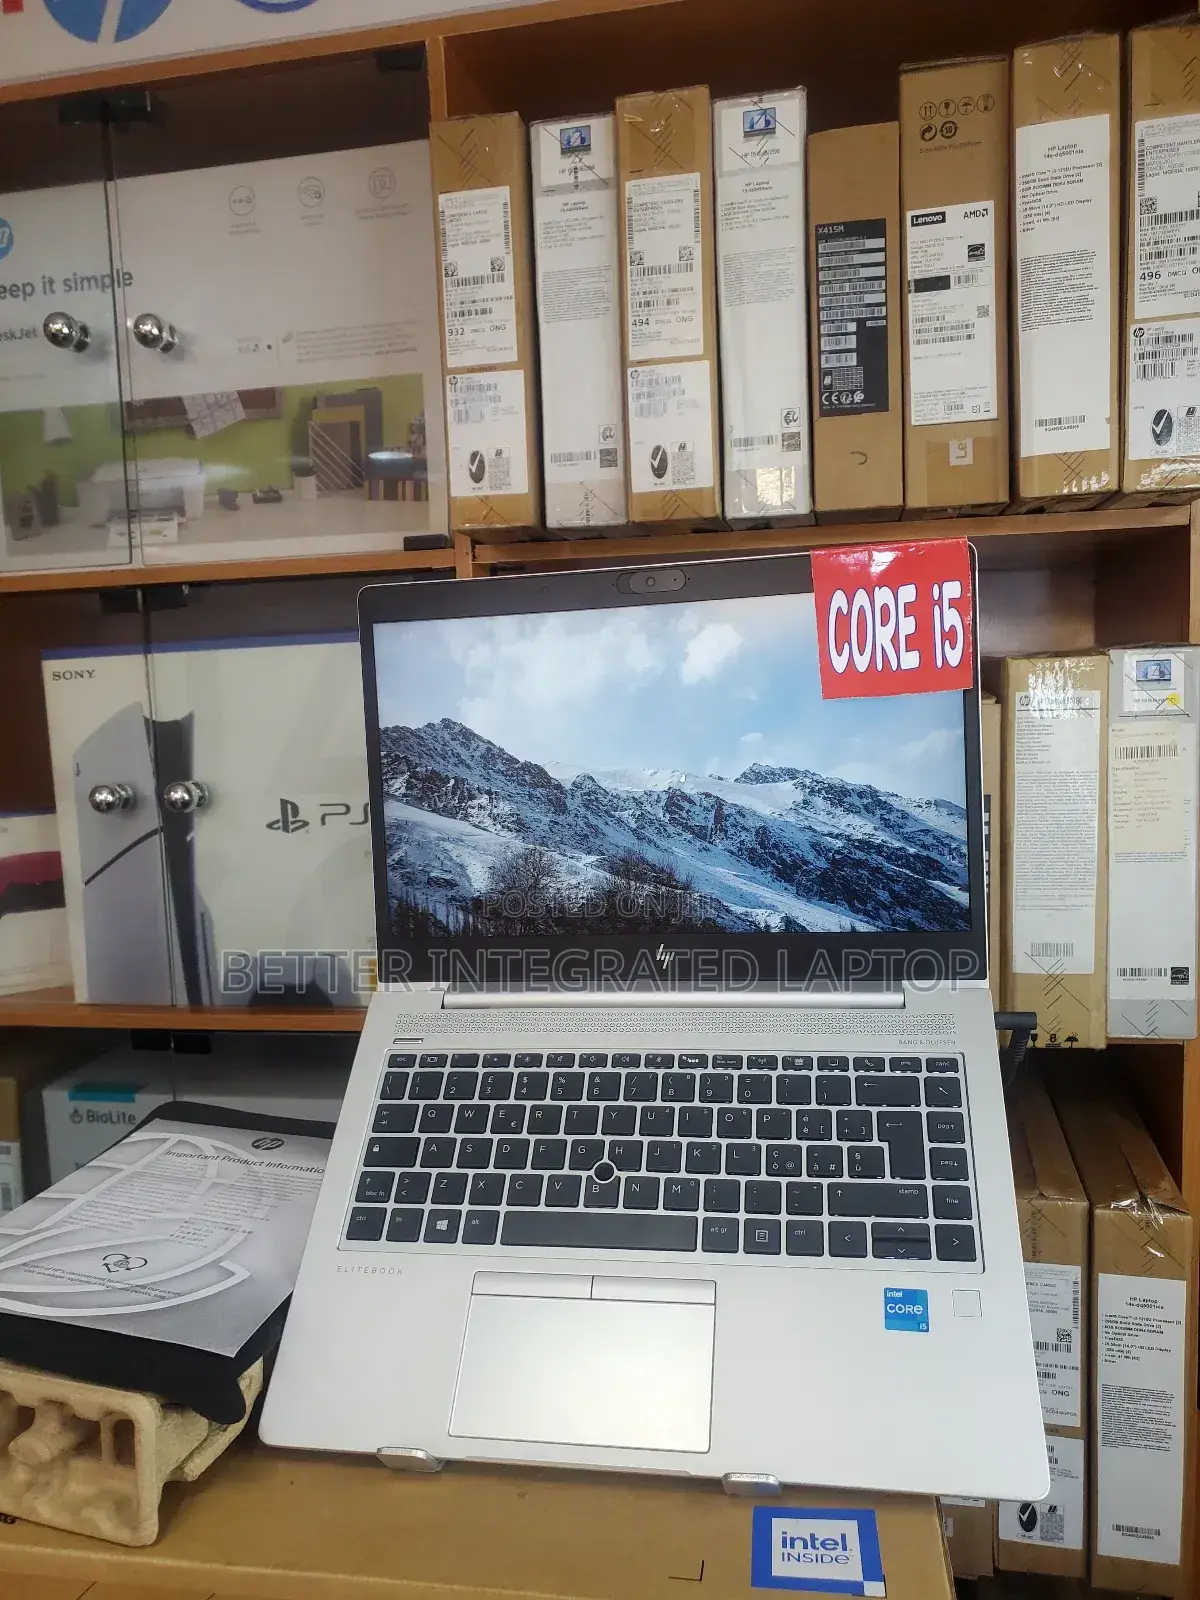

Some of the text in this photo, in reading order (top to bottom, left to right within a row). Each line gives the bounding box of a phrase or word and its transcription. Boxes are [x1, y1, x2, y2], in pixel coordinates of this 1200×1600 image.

[1176, 139, 1200, 147] HANDLER
[913, 209, 981, 225] Lenovo AMD
[818, 225, 845, 235] X415M
[1140, 270, 1162, 281] 496
[0, 268, 134, 301] eep it simple
[631, 318, 650, 327] 494
[675, 315, 694, 323] ONG
[0, 327, 38, 341] skJet
[448, 327, 465, 336] 932
[828, 580, 964, 674] CORE i5
[52, 668, 97, 682] SONY
[319, 801, 370, 826] PS
[449, 1086, 456, 1094] 2
[557, 1087, 563, 1095] 5
[86, 1108, 137, 1125] BioLite
[428, 1109, 436, 1119] Q
[464, 1109, 476, 1118] W
[499, 1110, 506, 1118] E
[535, 1110, 543, 1119] R
[572, 1111, 579, 1119] T
[611, 1111, 618, 1120] Y
[647, 1112, 655, 1120] U
[725, 1113, 734, 1122] O
[430, 1144, 437, 1152] A
[466, 1144, 473, 1152] S
[502, 1145, 511, 1153] D
[539, 1145, 547, 1153] F
[578, 1145, 586, 1154] G
[615, 1147, 623, 1155] H
[654, 1147, 660, 1156] J
[693, 1148, 701, 1157] K
[733, 1150, 740, 1158] L
[165, 1150, 325, 1174] Important Product Informatio
[440, 1179, 448, 1188] Z
[477, 1181, 486, 1189] X
[515, 1181, 524, 1190] C
[554, 1181, 562, 1190] V
[592, 1184, 600, 1193] B
[631, 1183, 640, 1192] N
[672, 1185, 681, 1193] M
[336, 1266, 404, 1275] ELITEBOOK
[886, 1290, 903, 1298] intel
[1051, 1389, 1070, 1397] ONG
[781, 1531, 848, 1552] intel
